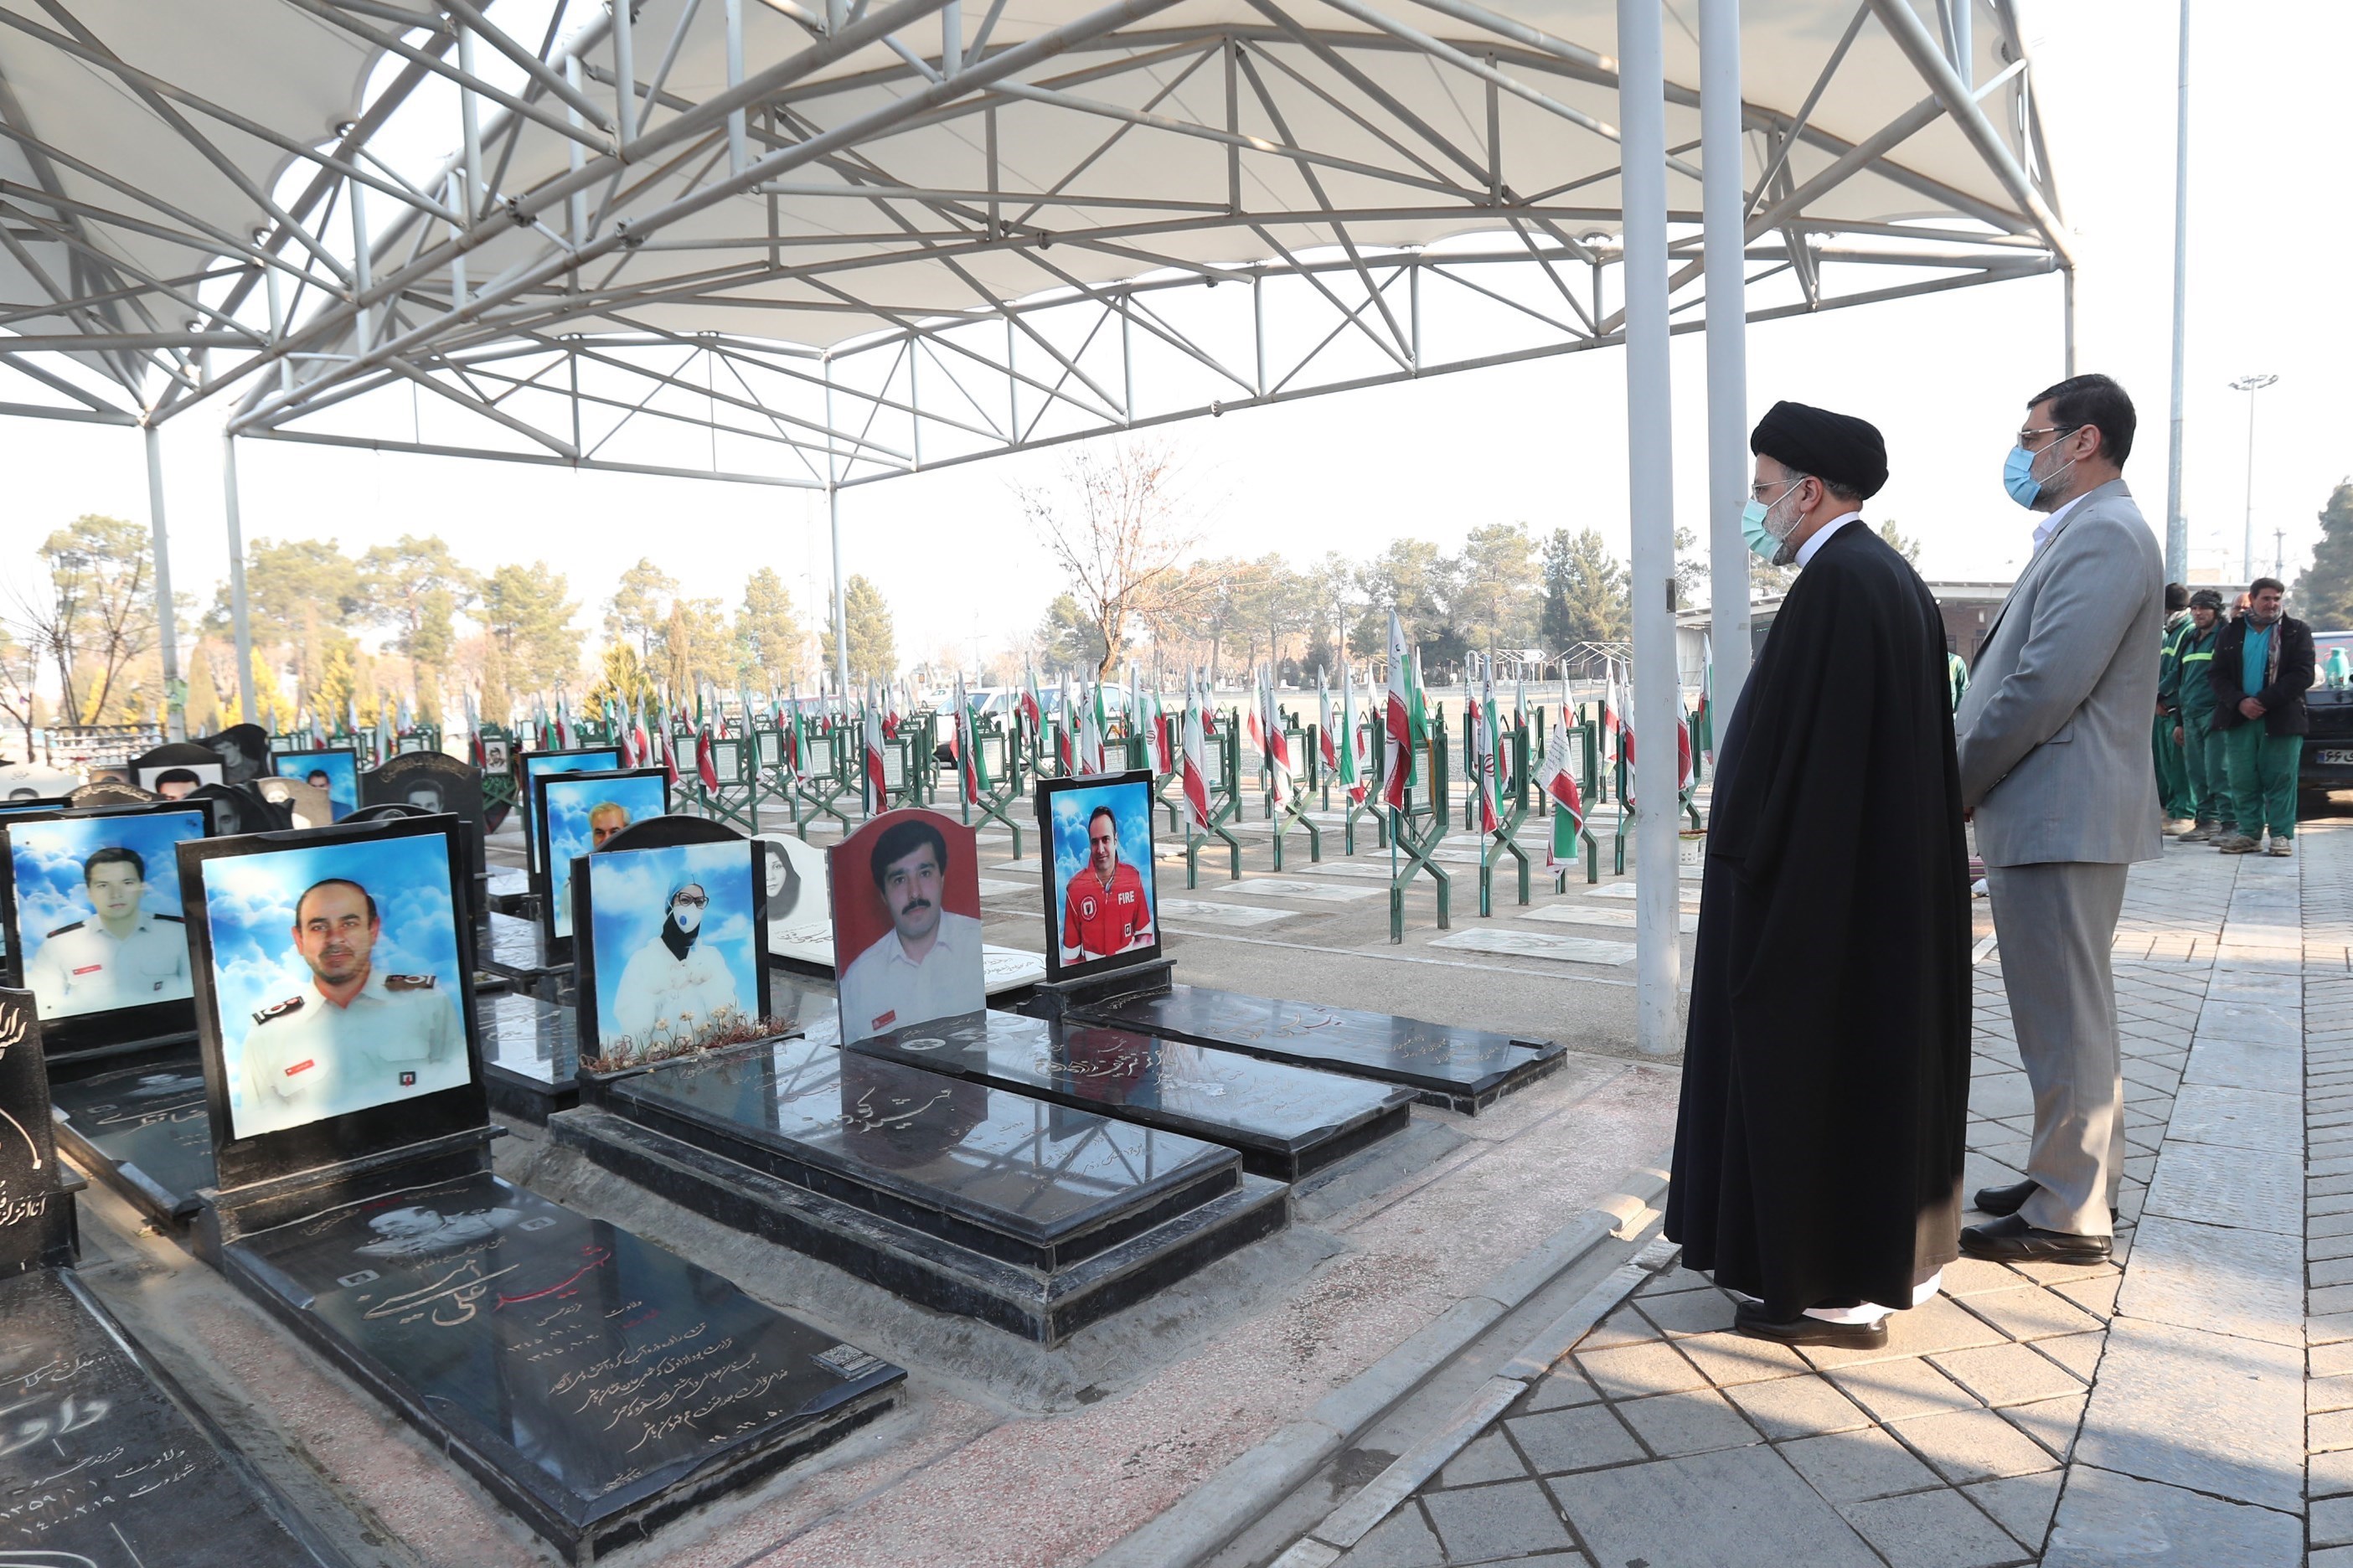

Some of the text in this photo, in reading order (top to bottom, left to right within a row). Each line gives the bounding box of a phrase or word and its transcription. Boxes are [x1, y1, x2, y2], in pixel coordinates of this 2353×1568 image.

[1118, 890, 1135, 905] FIRE
[604, 1300, 642, 1318] ولادت
[88, 1446, 125, 1467] فرزند
[115, 1448, 186, 1479] ولادت
[128, 1462, 196, 1498] شهادت
